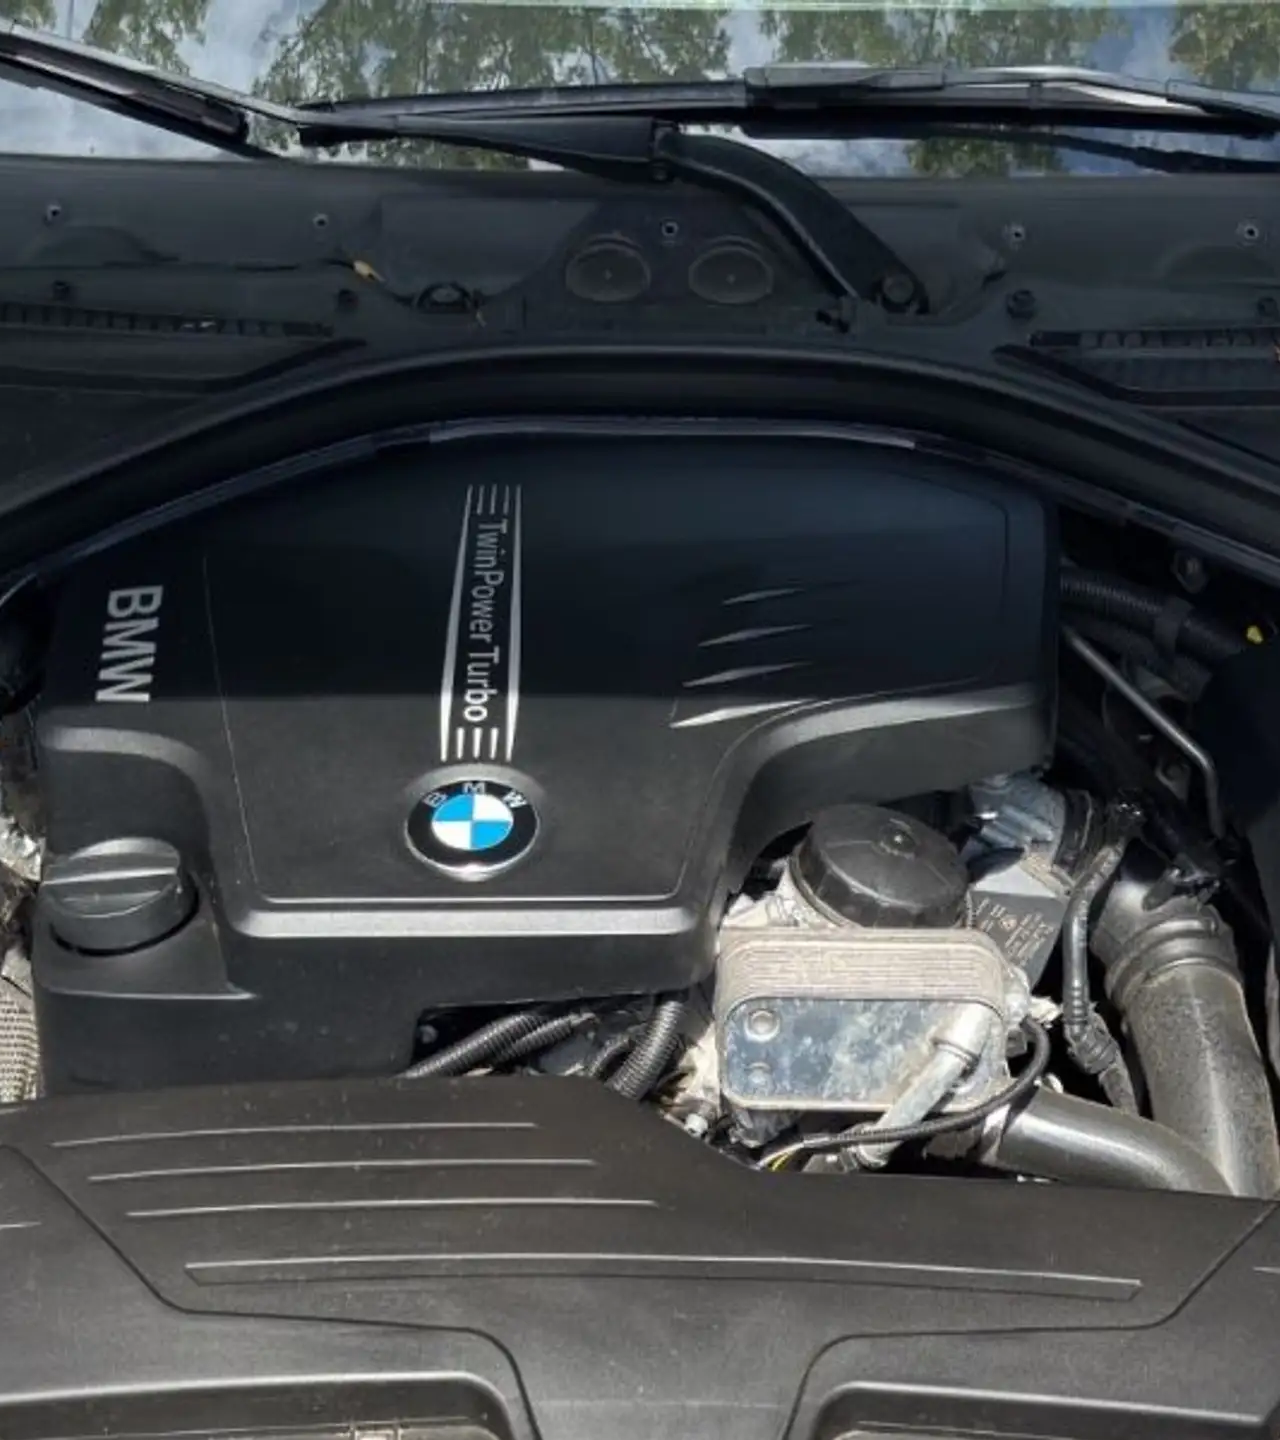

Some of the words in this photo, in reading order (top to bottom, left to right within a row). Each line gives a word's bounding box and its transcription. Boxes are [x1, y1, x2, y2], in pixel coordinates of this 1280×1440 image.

[468, 518, 508, 645] TwinPower
[95, 585, 163, 702] BMW
[463, 645, 500, 723] Turbo
[423, 781, 527, 810] BMW
